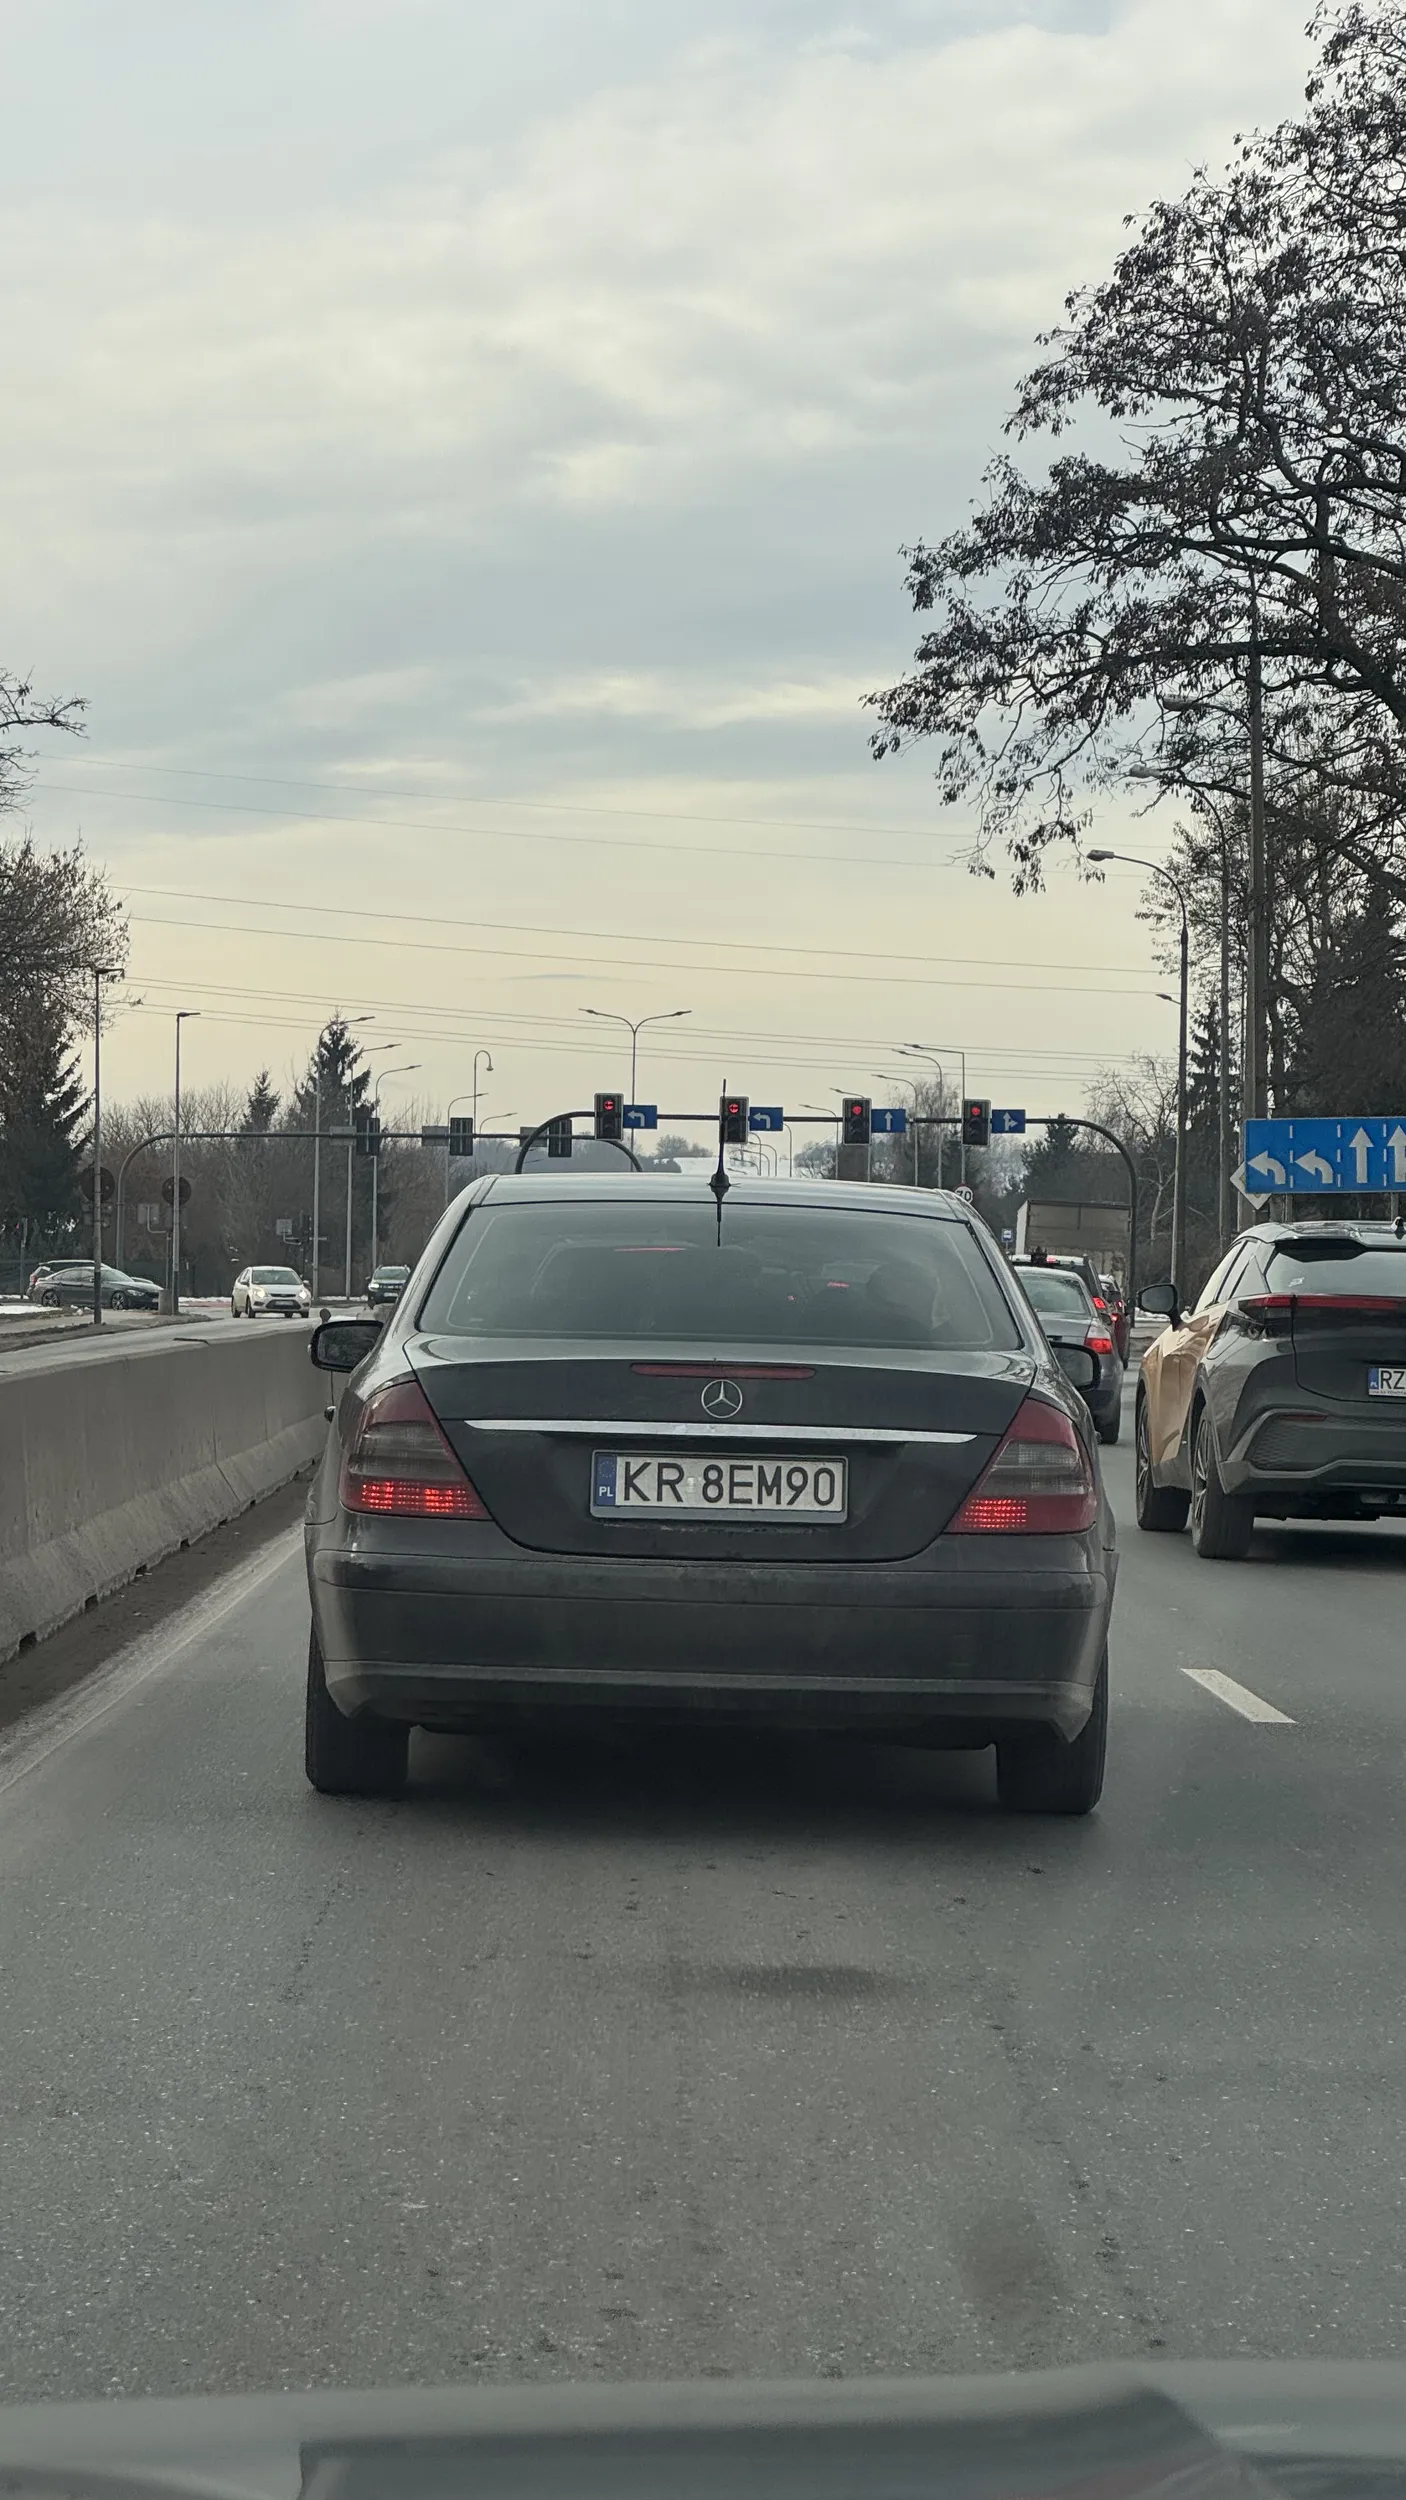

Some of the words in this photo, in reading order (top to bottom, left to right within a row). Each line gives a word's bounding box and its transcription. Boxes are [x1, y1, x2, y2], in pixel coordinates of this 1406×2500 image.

[1380, 1370, 1405, 1389] RZ
[599, 1486, 614, 1497] PL
[624, 1461, 685, 1502] KR
[702, 1464, 836, 1506] 8EM90
